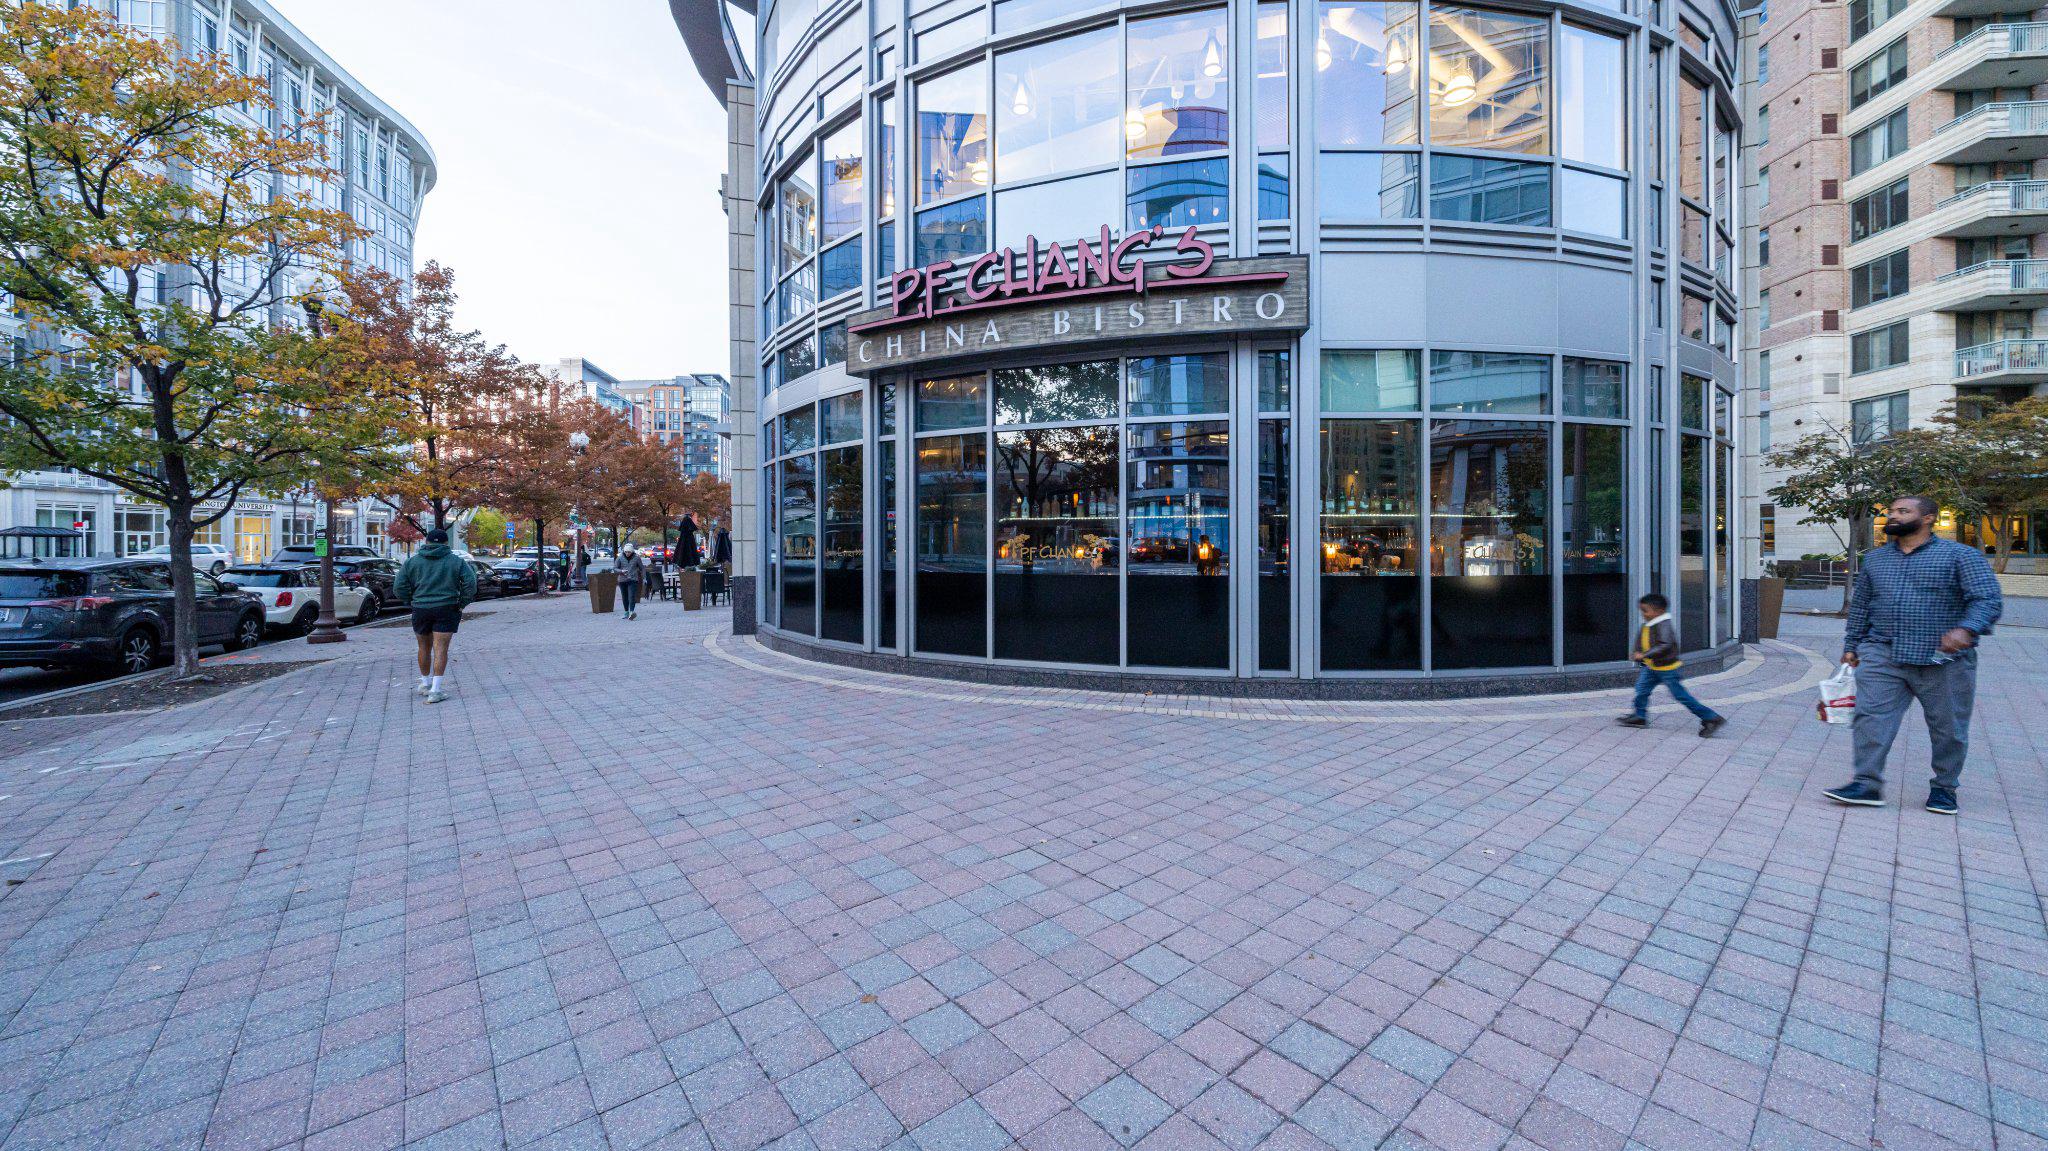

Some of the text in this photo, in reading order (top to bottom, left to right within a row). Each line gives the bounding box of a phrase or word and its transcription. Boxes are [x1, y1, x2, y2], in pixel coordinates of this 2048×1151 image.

[965, 223, 1214, 301] CHANG'S
[858, 292, 1285, 363] CHINA BISTRO
